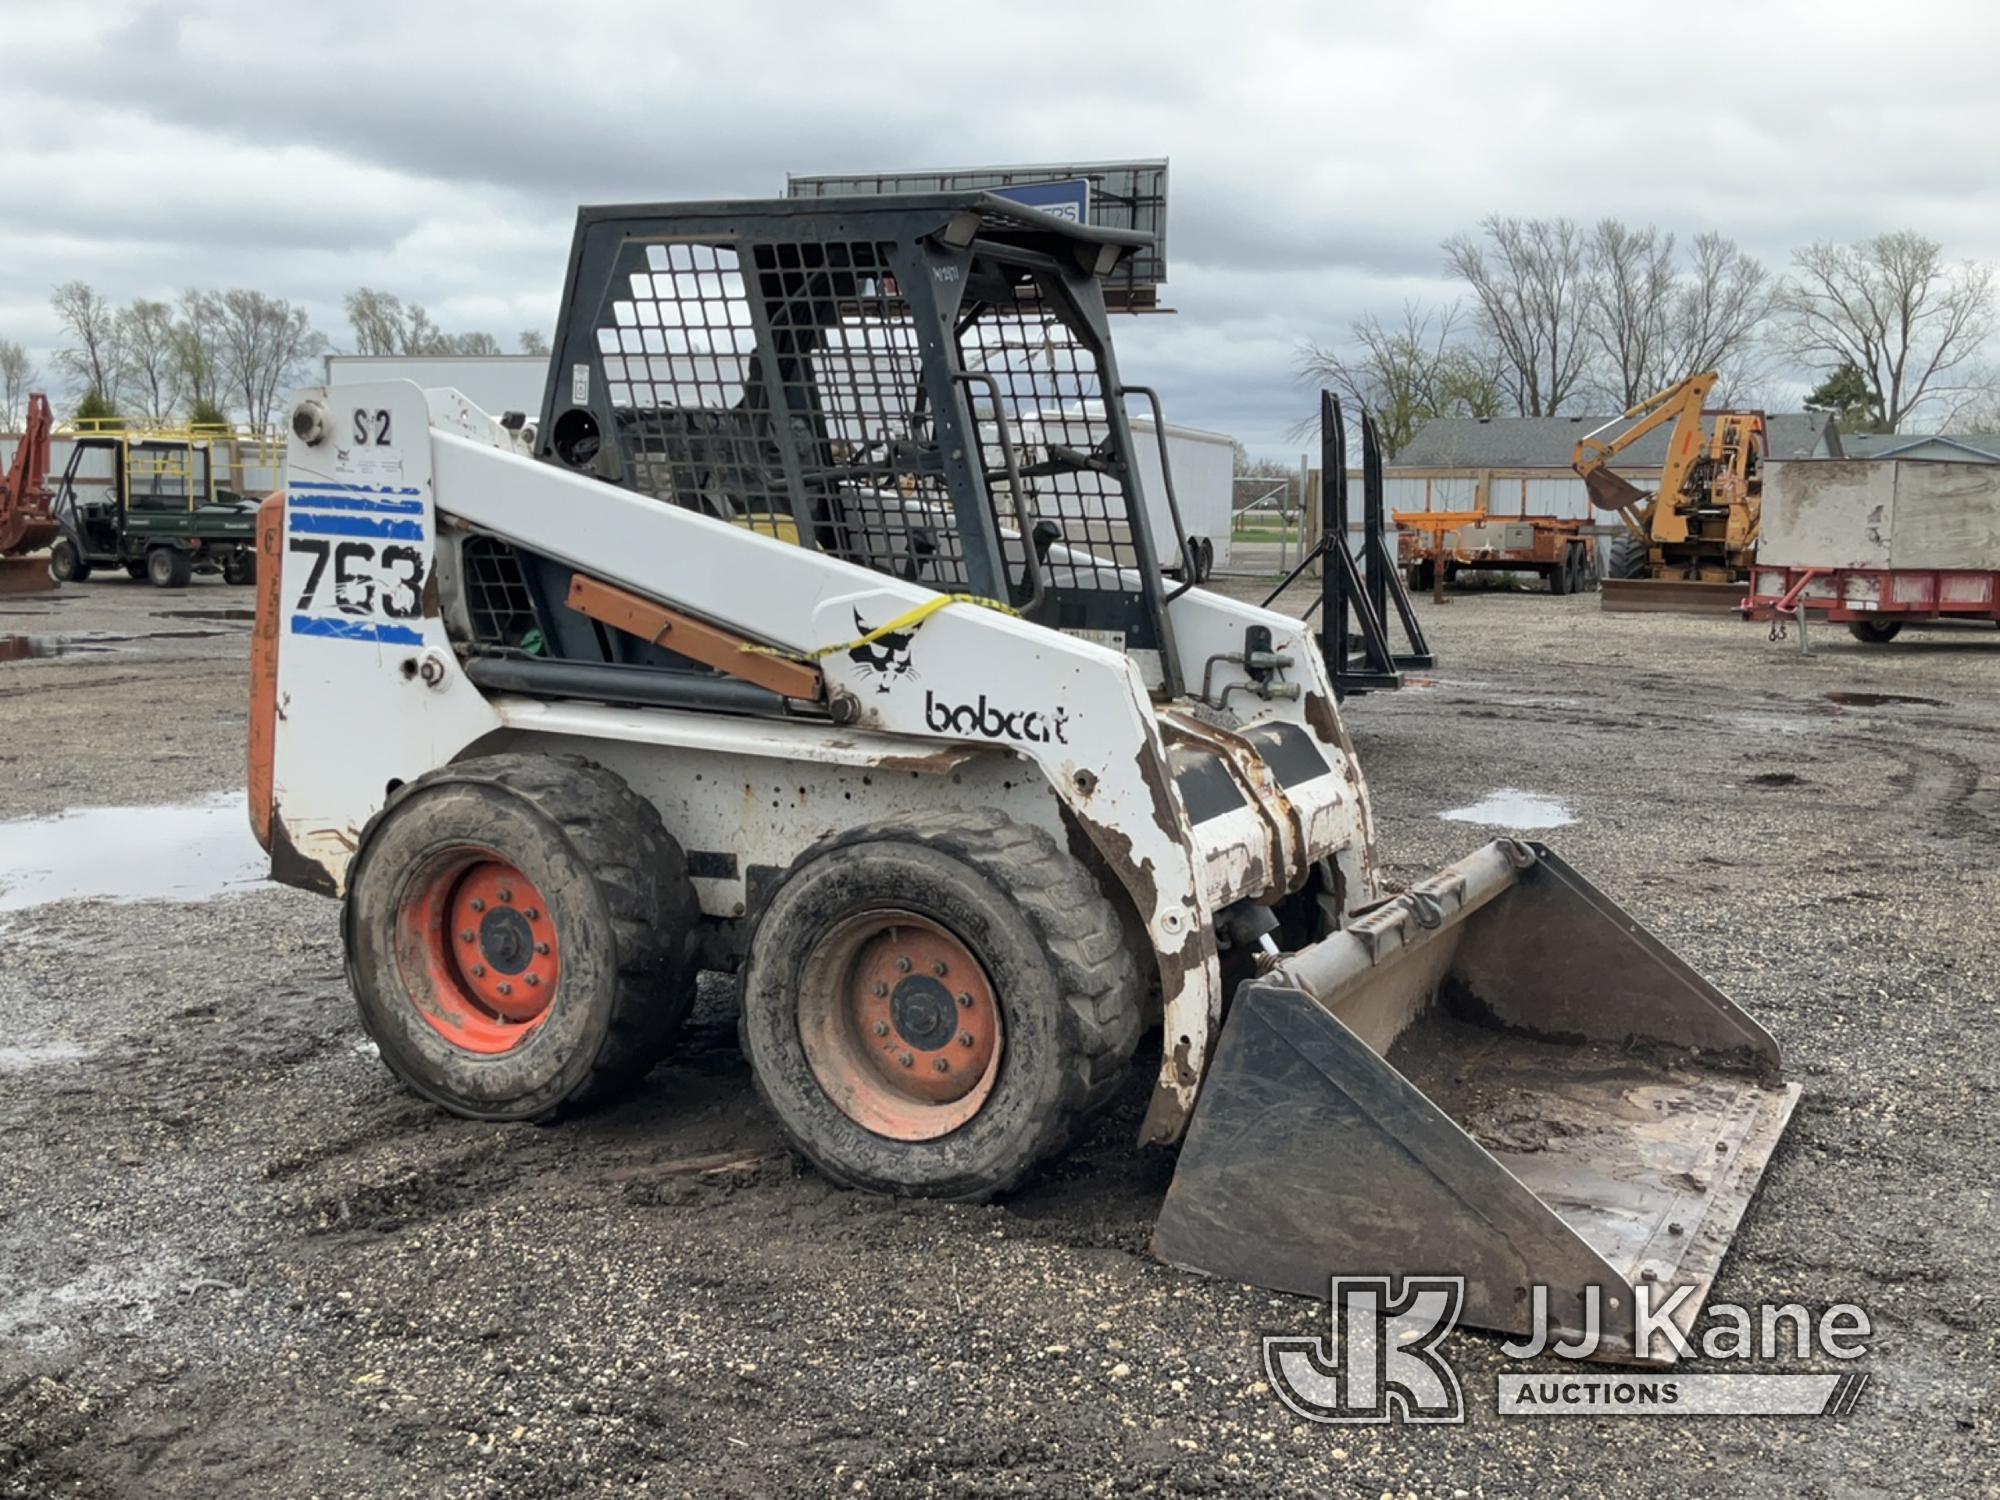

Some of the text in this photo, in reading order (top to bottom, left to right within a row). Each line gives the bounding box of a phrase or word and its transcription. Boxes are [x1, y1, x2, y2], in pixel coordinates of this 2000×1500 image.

[354, 408, 391, 446] S2
[289, 538, 424, 619] 763
[926, 689, 1068, 744] bobcat
